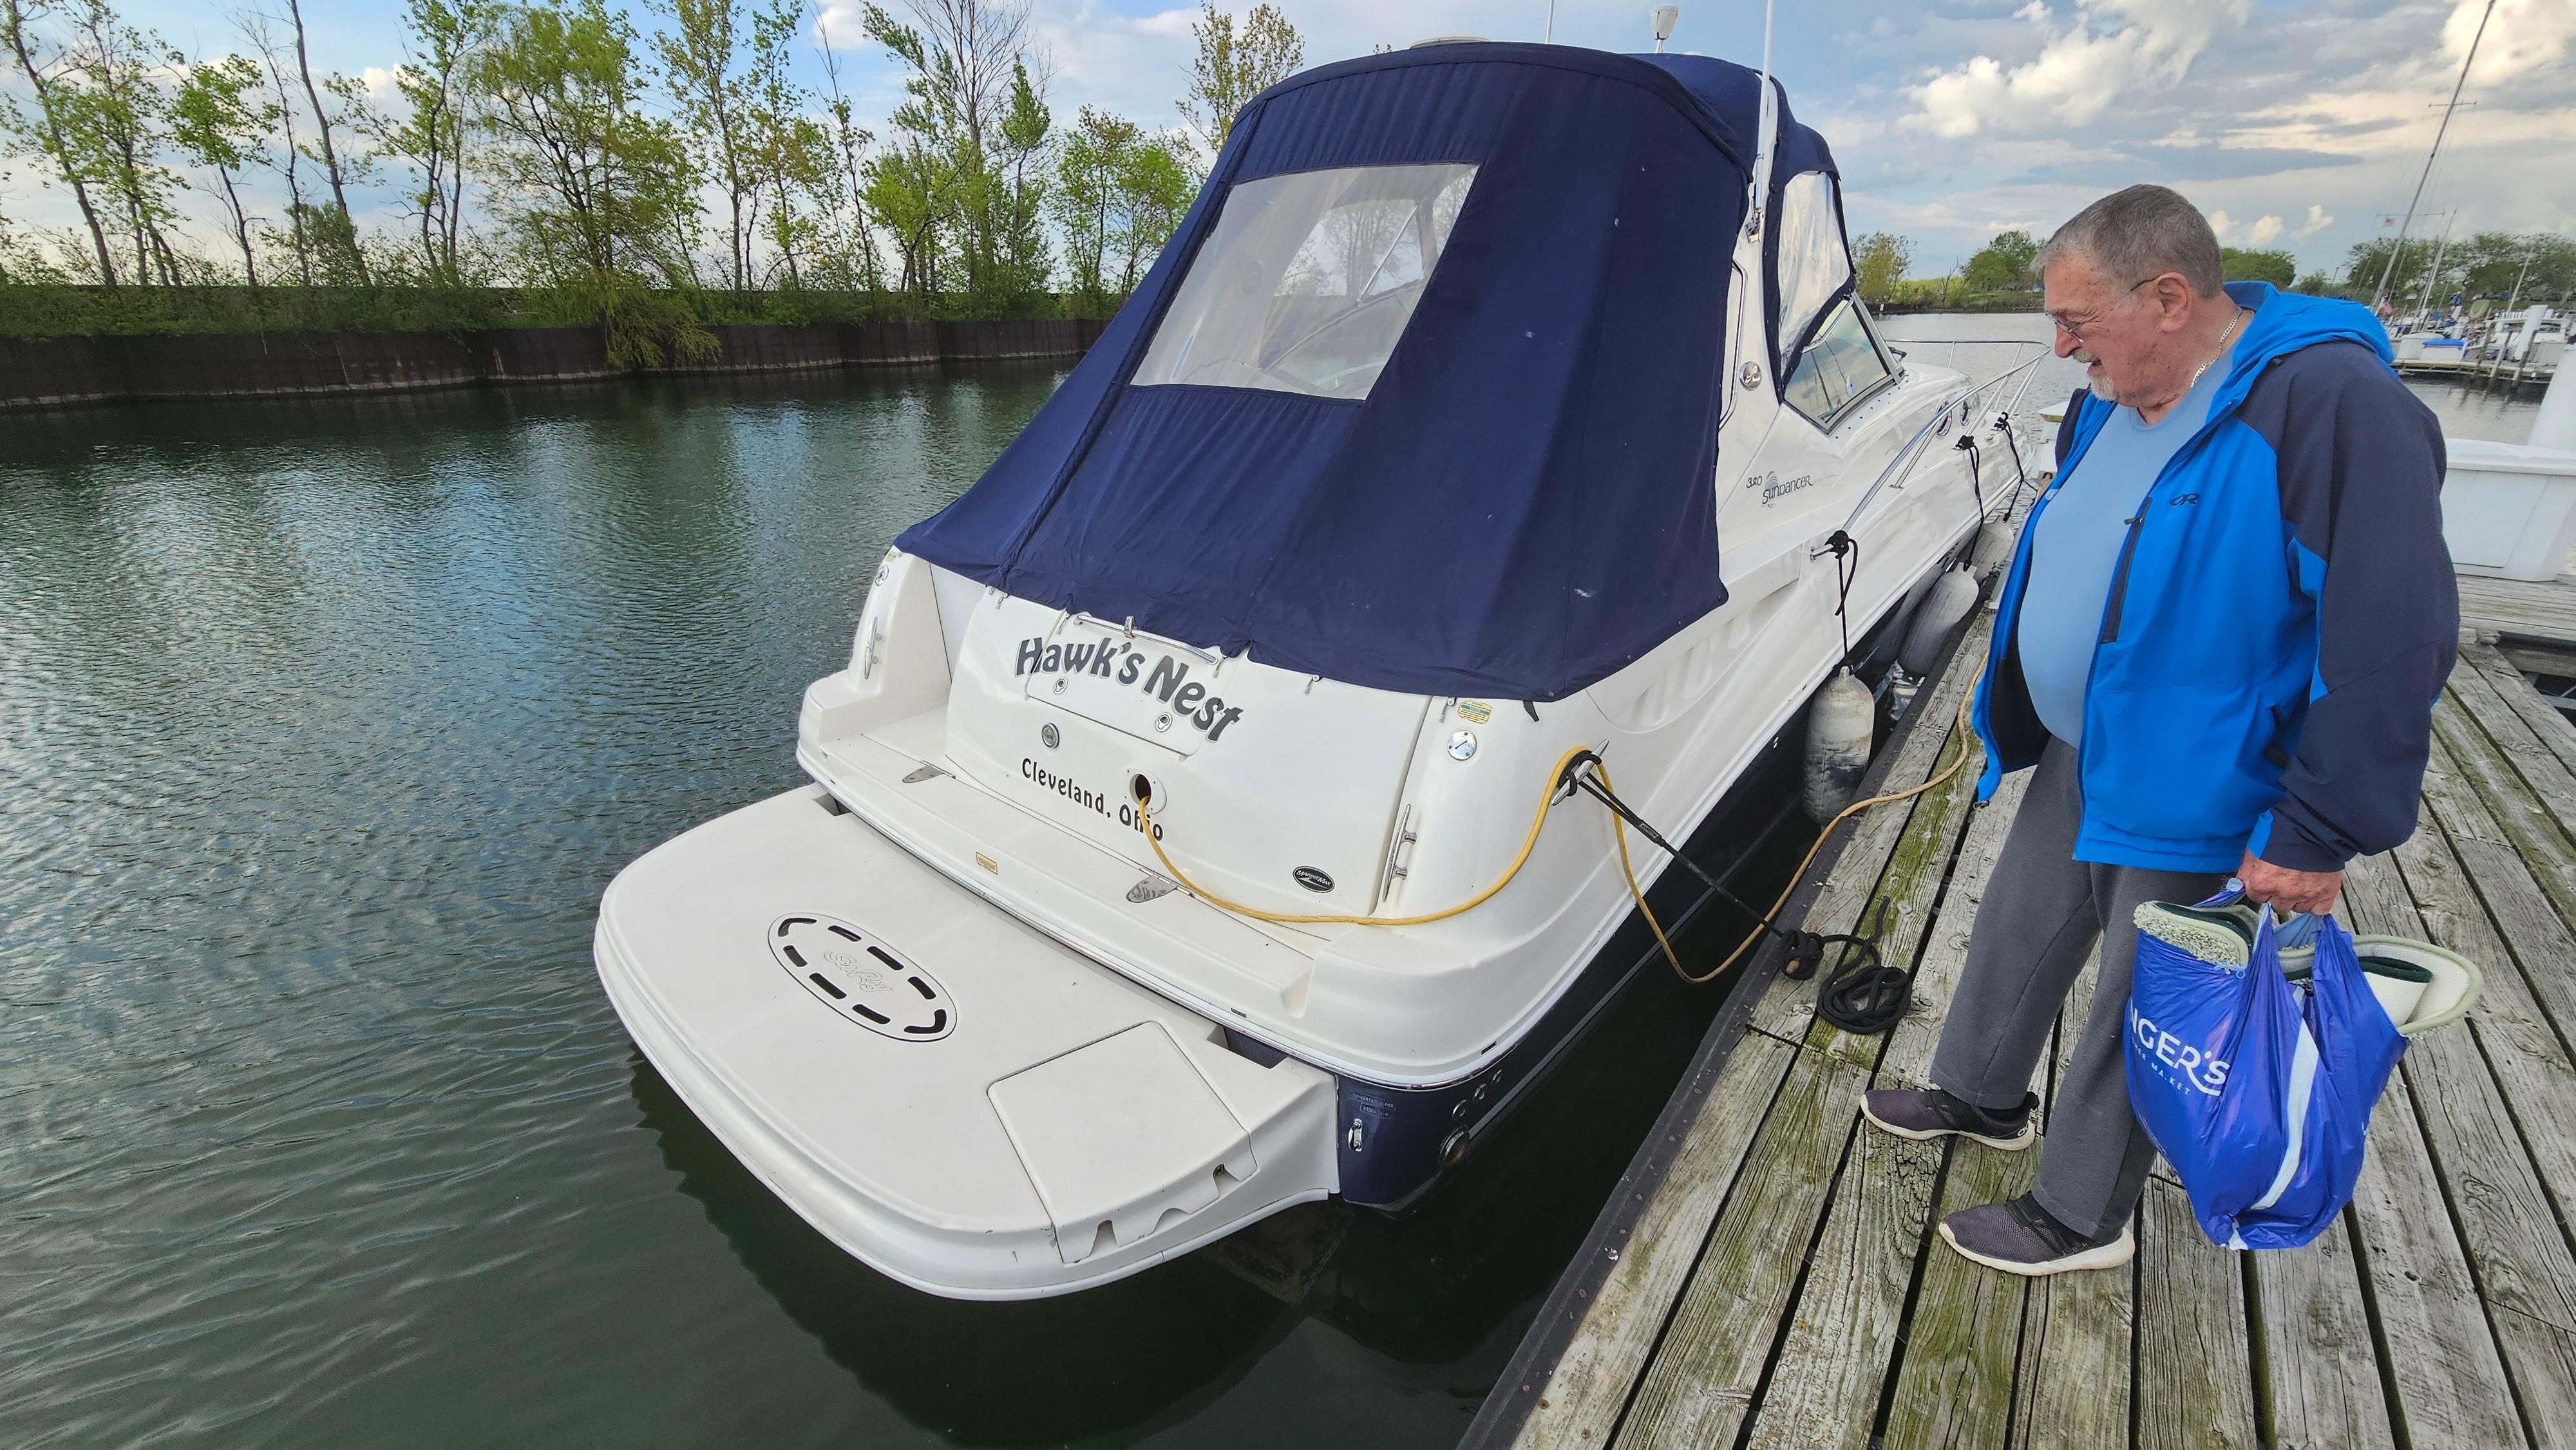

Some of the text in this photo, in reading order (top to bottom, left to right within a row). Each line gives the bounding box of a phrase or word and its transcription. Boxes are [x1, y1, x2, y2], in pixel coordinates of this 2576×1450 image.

[1014, 637, 1244, 743] Hawk's Nest
[1021, 757, 1112, 818] Cleveland,
